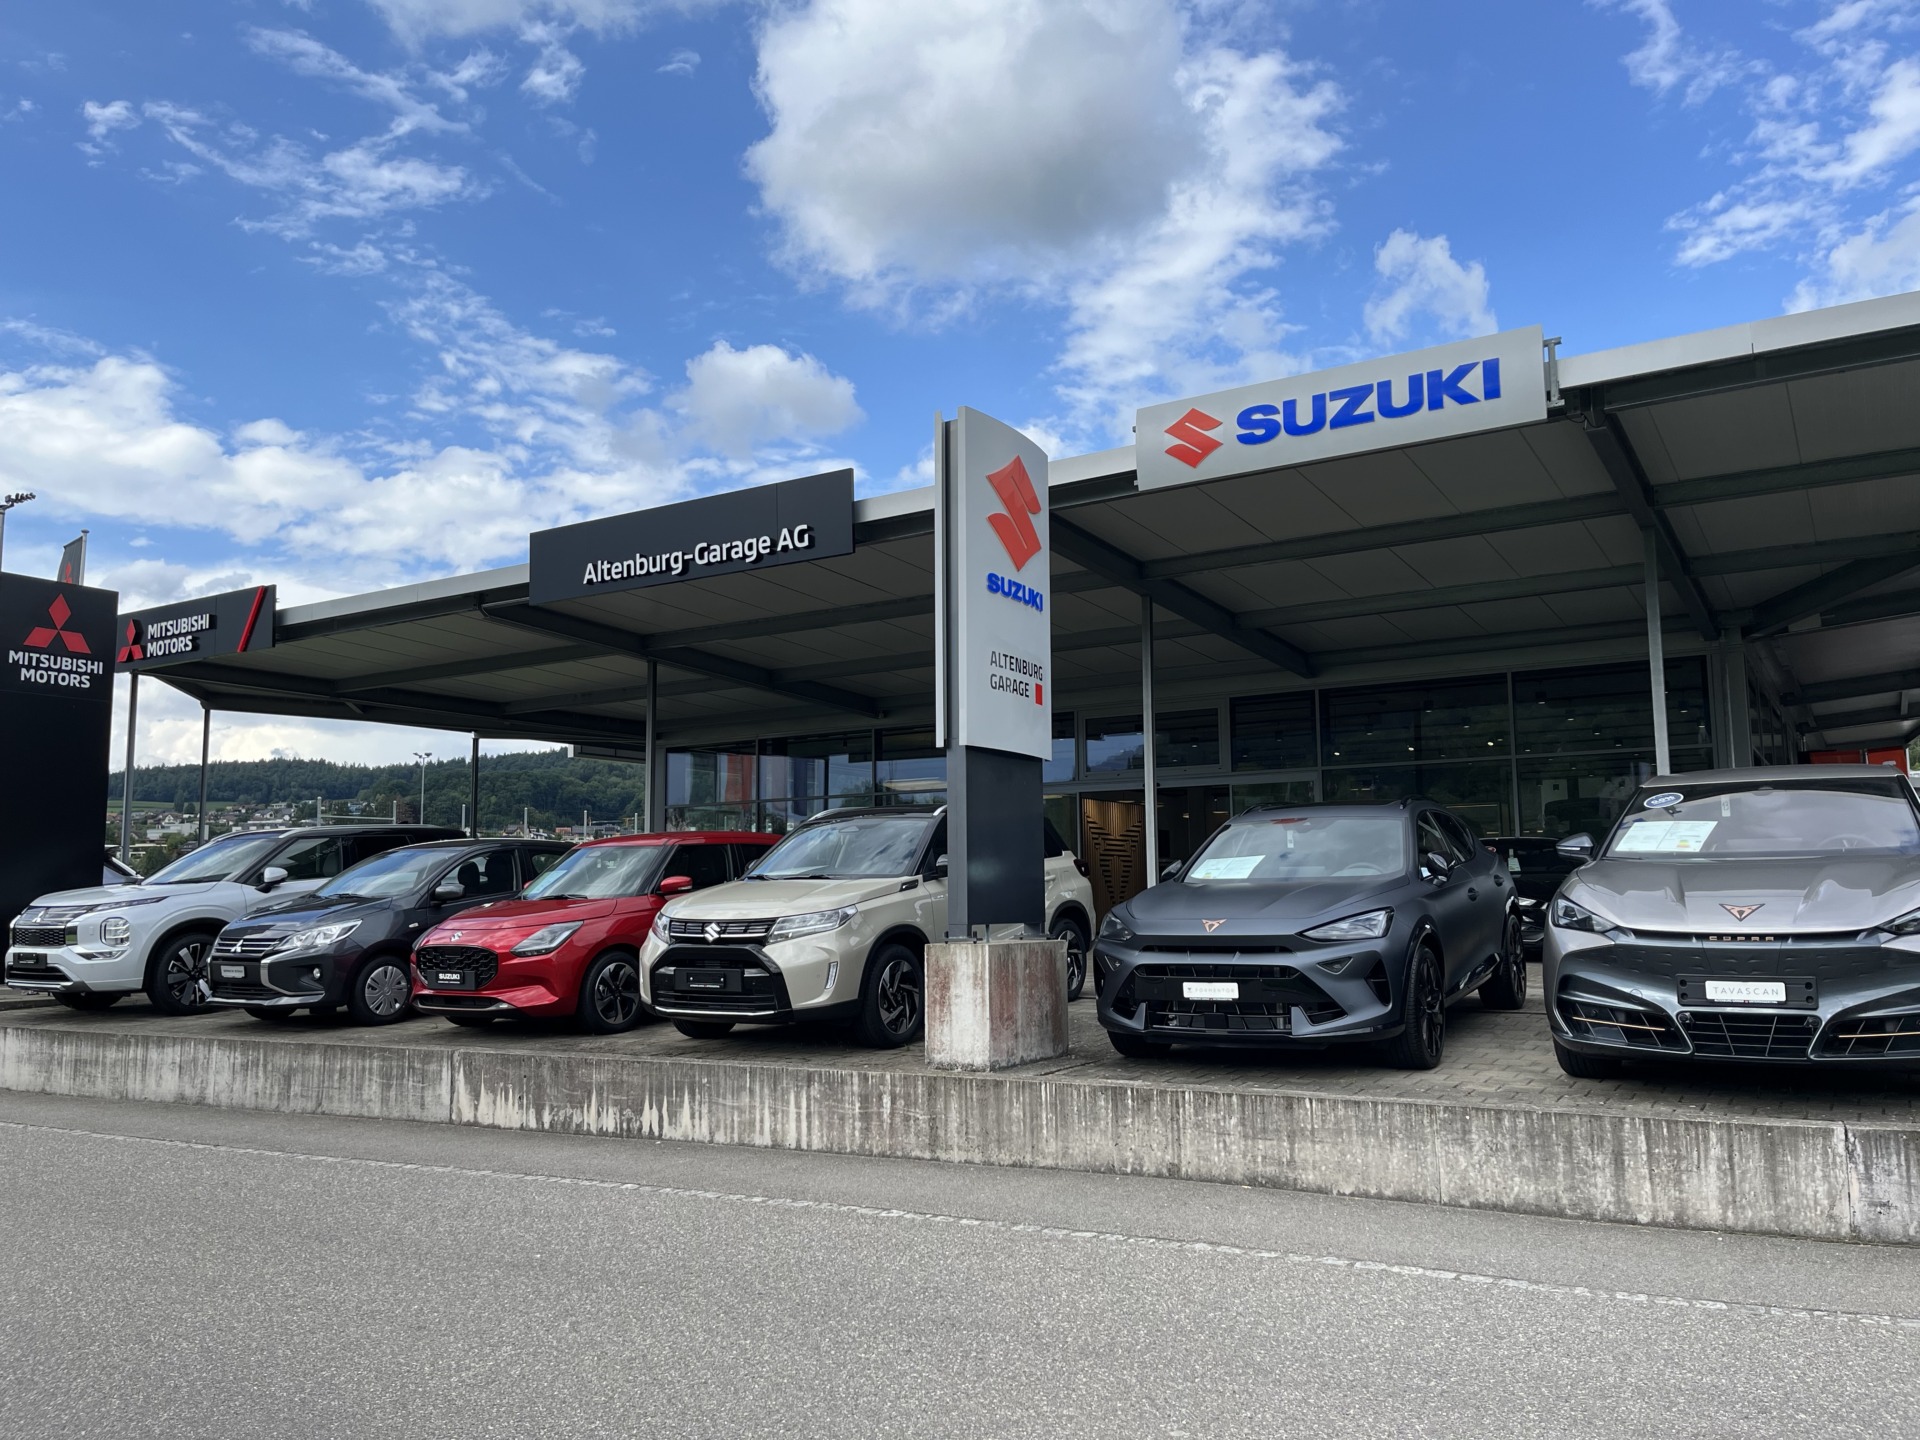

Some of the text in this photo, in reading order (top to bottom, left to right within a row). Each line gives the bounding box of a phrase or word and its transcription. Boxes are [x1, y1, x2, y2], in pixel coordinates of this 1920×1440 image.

[1235, 357, 1502, 446] SUZUKI
[583, 524, 810, 585] Altenburg-Garage AG
[986, 572, 1044, 612] SUZUKI
[147, 613, 210, 639] MITSUBISHI
[146, 635, 193, 658] MOTORS
[8, 650, 104, 675] MITSUBISHI
[990, 651, 1043, 681] ALTENBURG
[20, 667, 91, 689] MOTORS
[990, 673, 1030, 699] GARAGE
[1713, 987, 1778, 995] TAVASCAN
